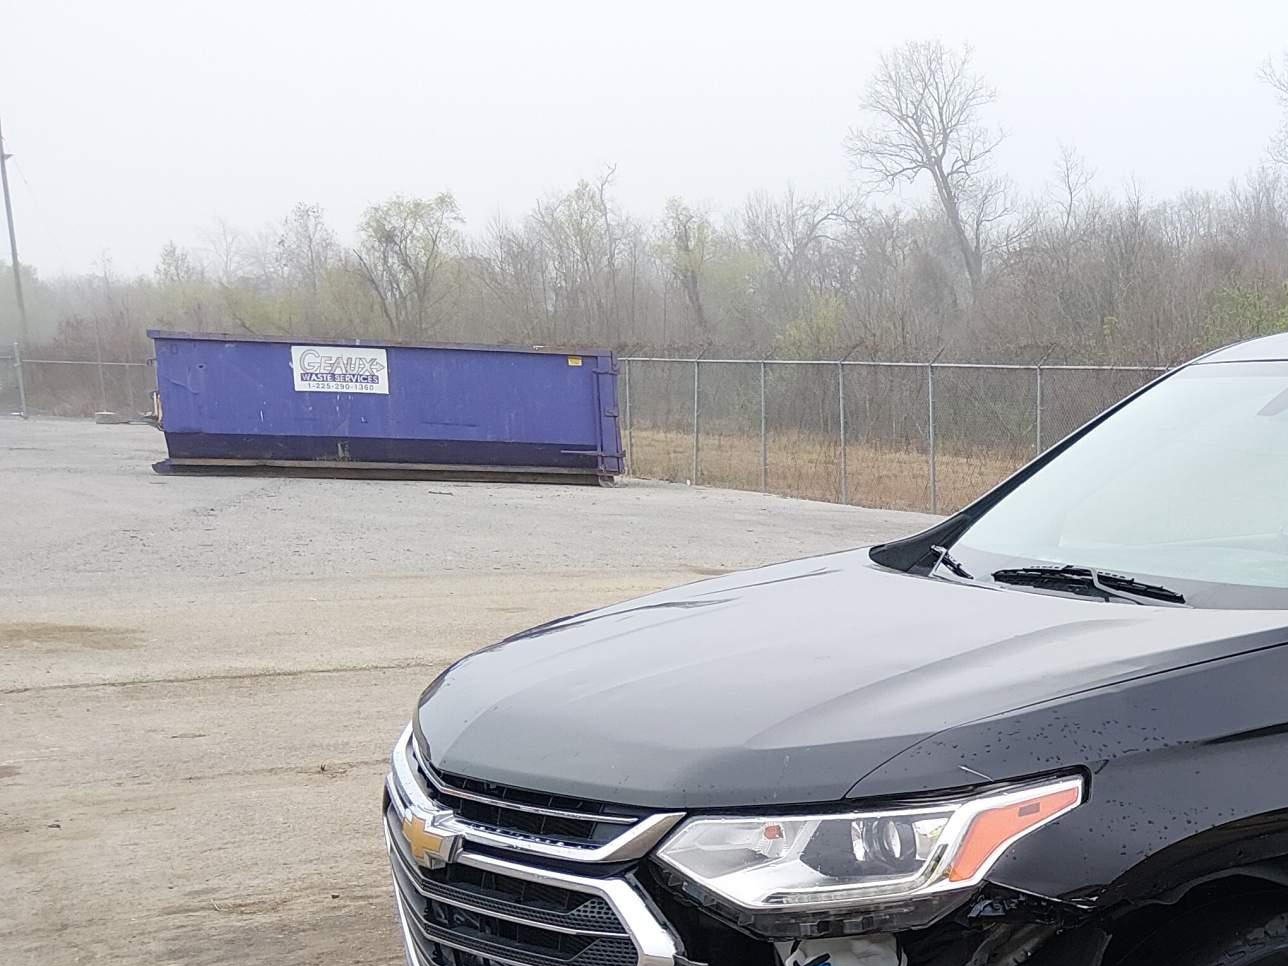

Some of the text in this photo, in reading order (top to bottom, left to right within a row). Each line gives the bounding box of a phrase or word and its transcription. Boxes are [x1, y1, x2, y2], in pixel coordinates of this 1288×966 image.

[300, 349, 376, 376] GEAUX
[302, 373, 378, 384] WASTE SERVICES
